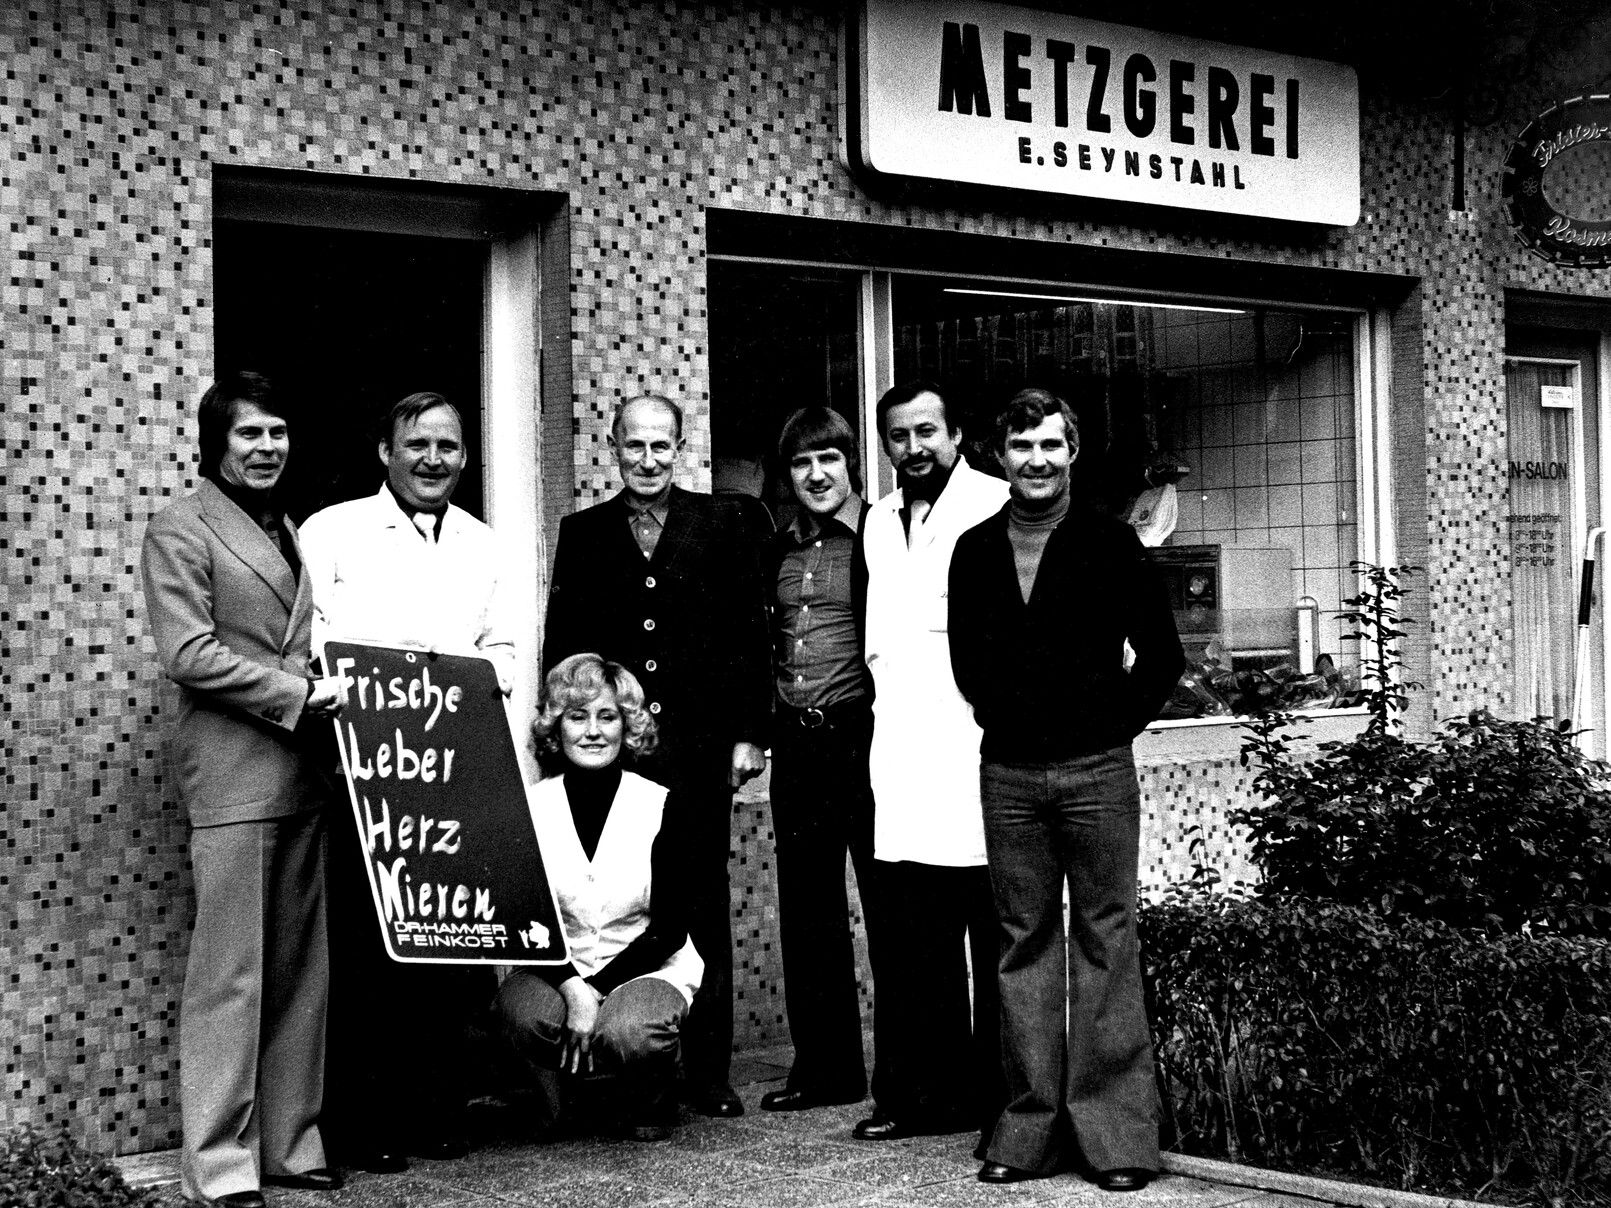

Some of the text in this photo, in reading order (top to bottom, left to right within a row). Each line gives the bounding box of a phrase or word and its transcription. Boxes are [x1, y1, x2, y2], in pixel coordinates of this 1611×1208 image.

[938, 21, 1300, 159] METZGEREI
[336, 657, 462, 732] Frische
[348, 721, 455, 783] Leber
[363, 796, 461, 854] Herz
[376, 857, 496, 923] Nieren
[396, 933, 509, 948] FEINKOST
